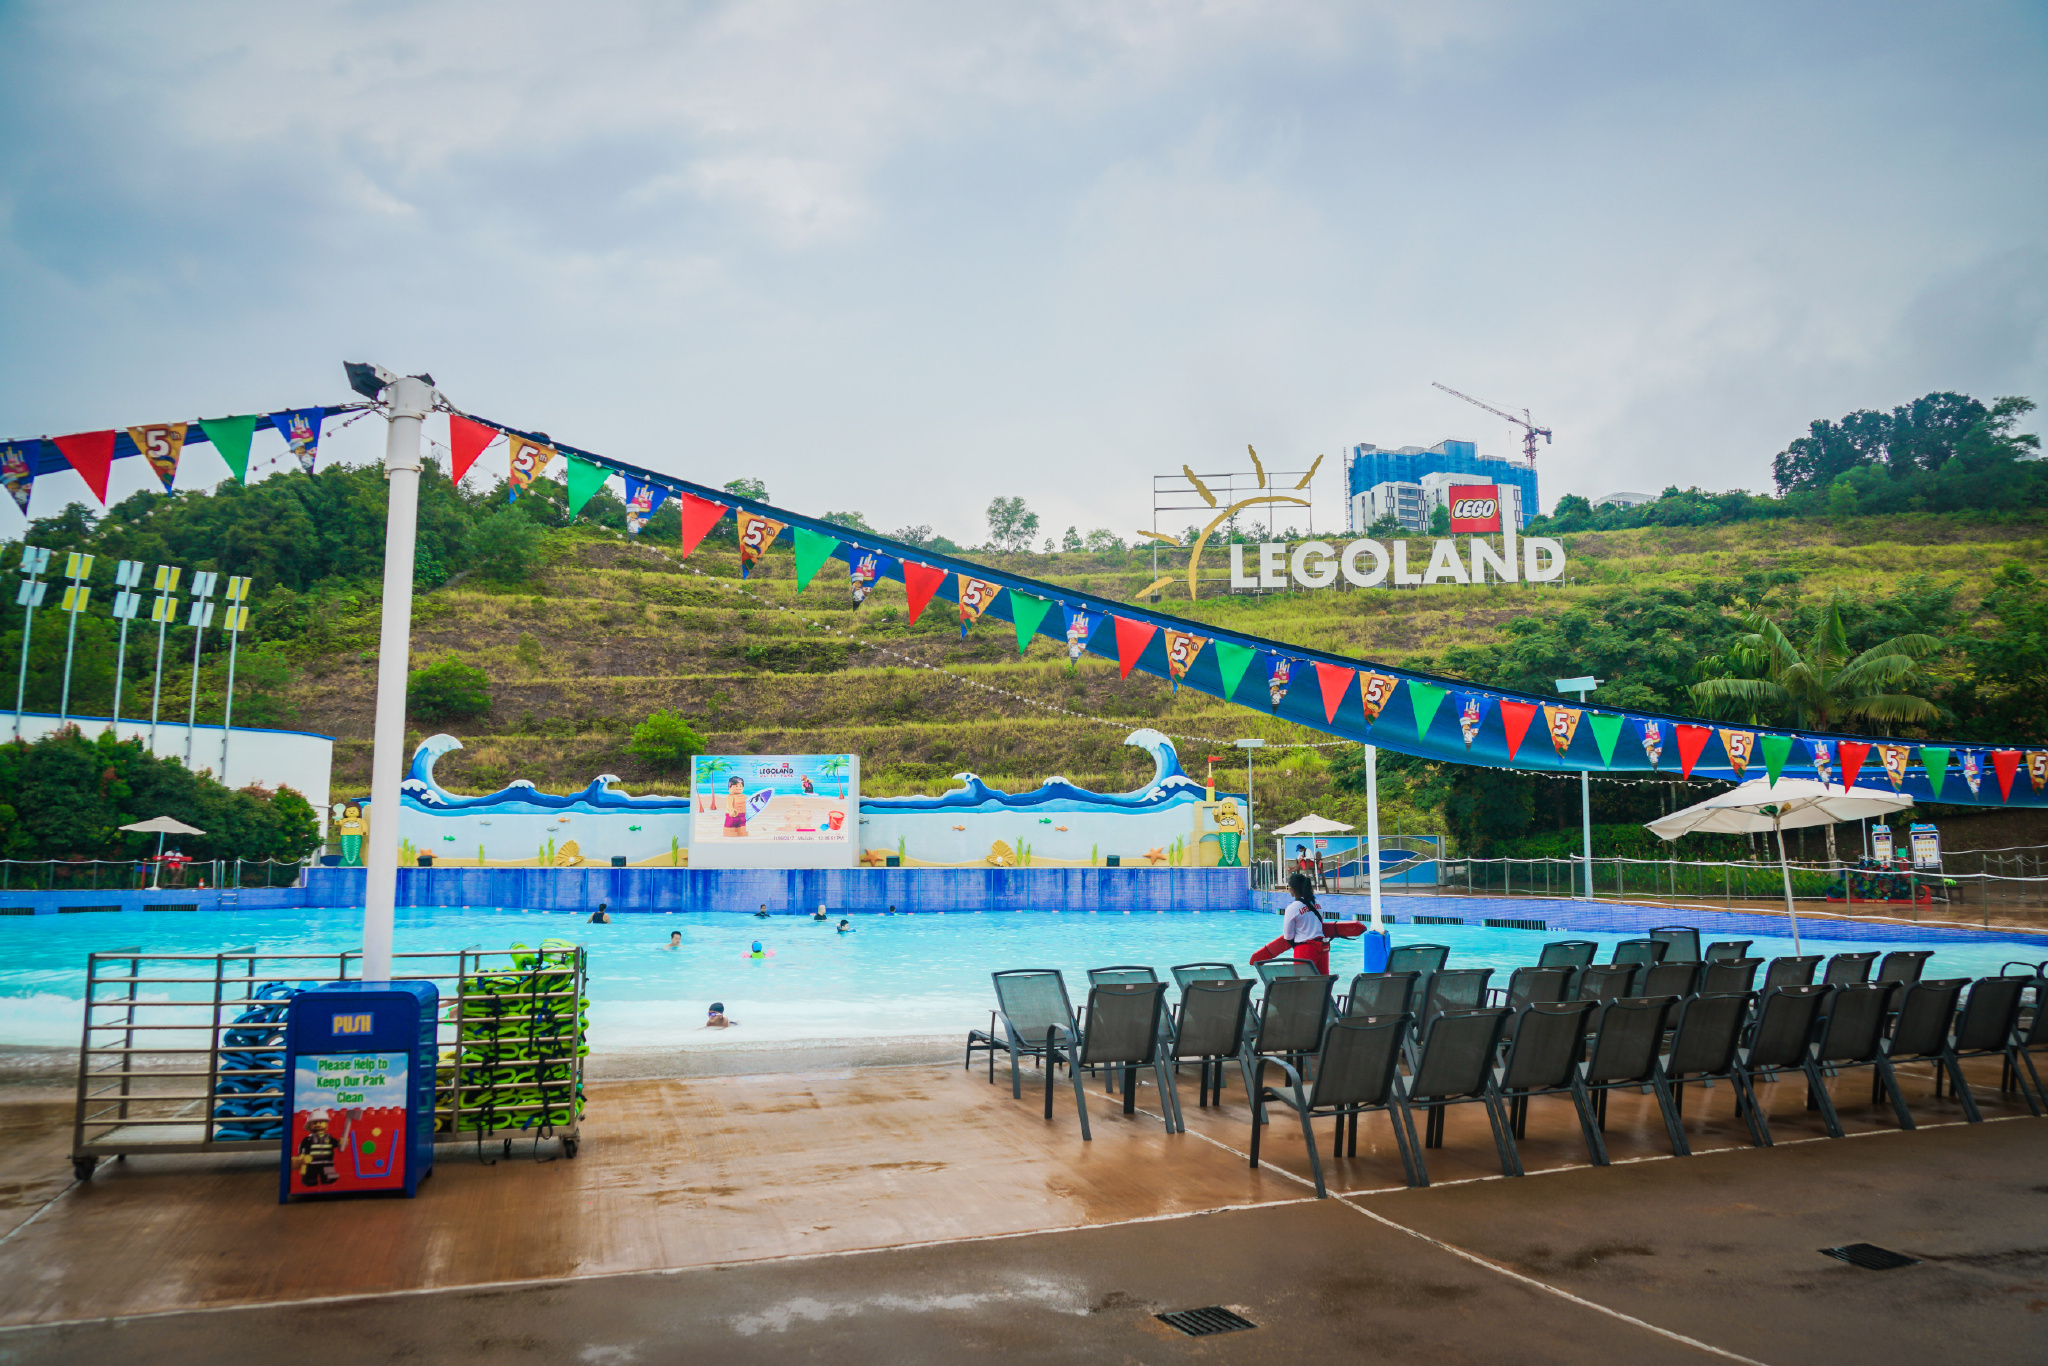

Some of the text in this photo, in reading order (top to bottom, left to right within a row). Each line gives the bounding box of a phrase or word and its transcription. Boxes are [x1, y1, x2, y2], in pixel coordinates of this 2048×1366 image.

[512, 444, 548, 472] 5th
[1453, 498, 1496, 519] LEGO
[742, 518, 775, 547] 5th
[1230, 484, 1566, 588] LEGOLAND
[962, 579, 993, 606] 5th
[759, 763, 794, 774] LEGOLAND
[333, 1015, 371, 1033] PUSH
[318, 1058, 388, 1072] Please Help to
[317, 1074, 385, 1089] Keep Our Park
[337, 1092, 363, 1103] Clean
